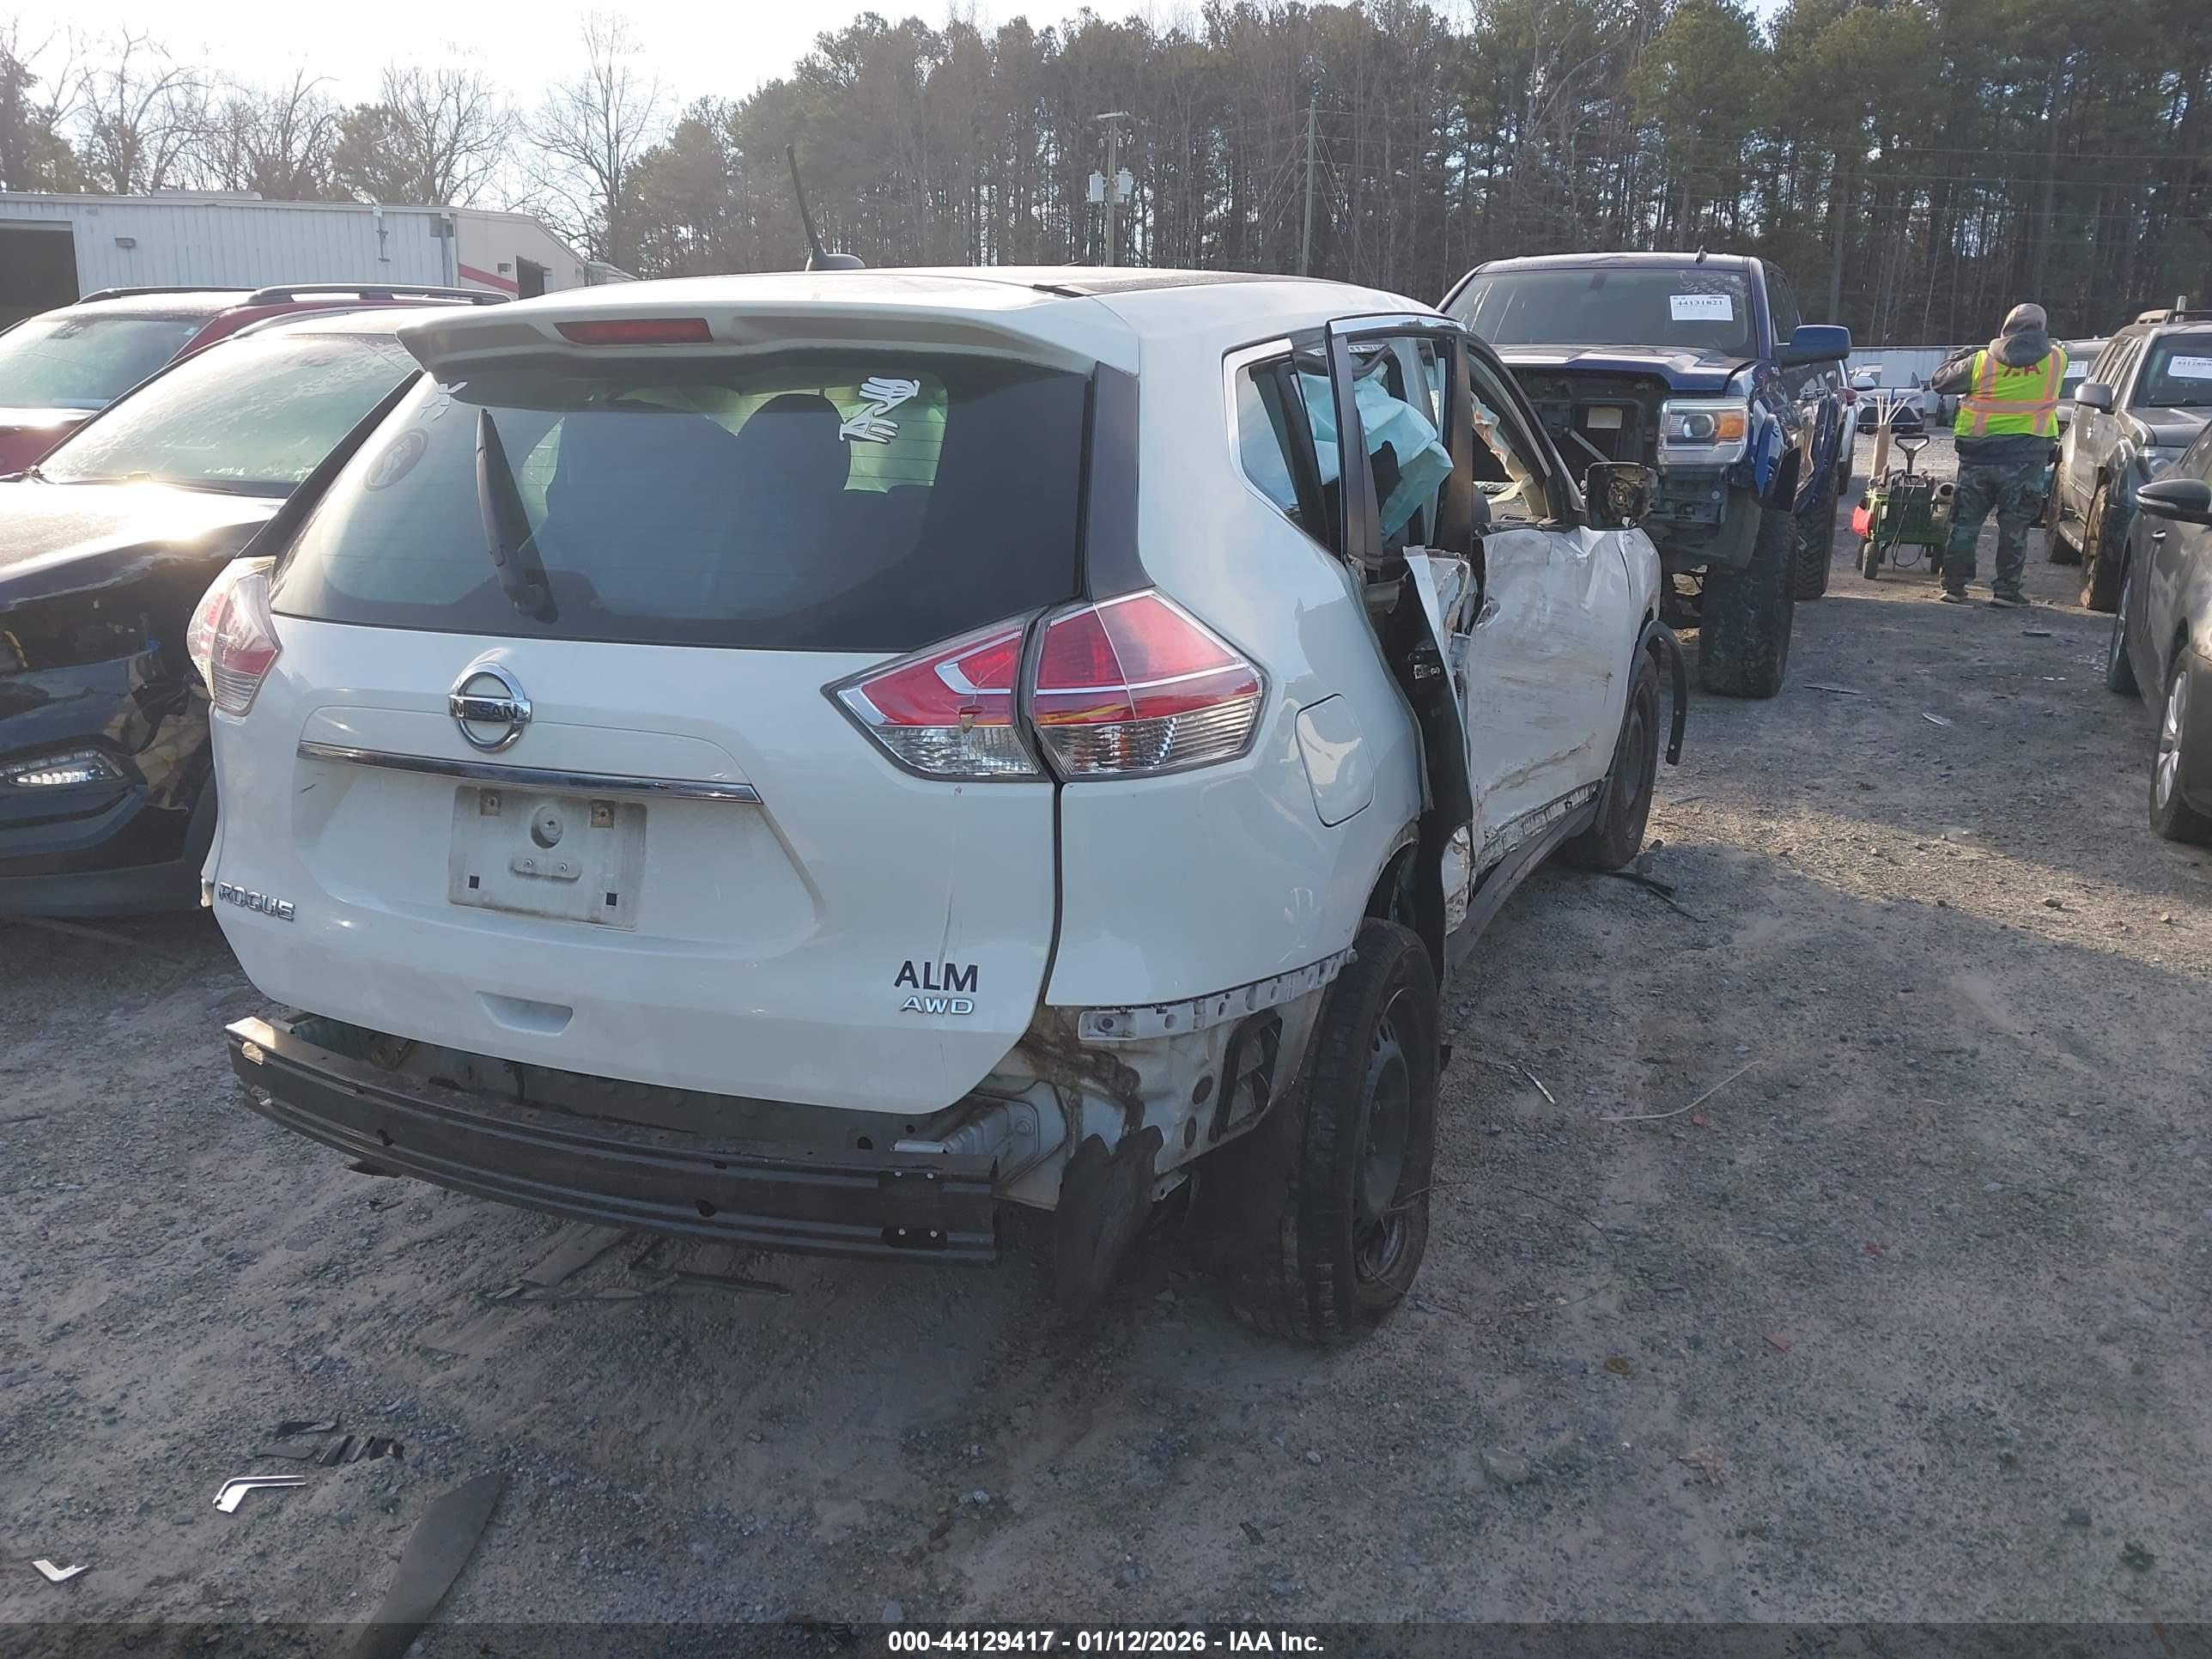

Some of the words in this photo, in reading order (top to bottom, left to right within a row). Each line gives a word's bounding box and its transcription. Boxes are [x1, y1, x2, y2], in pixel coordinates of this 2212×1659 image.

[453, 699, 519, 720] NISSAN
[219, 881, 295, 922] ROGUE
[894, 960, 978, 993] ALM
[900, 995, 975, 1015] AWD
